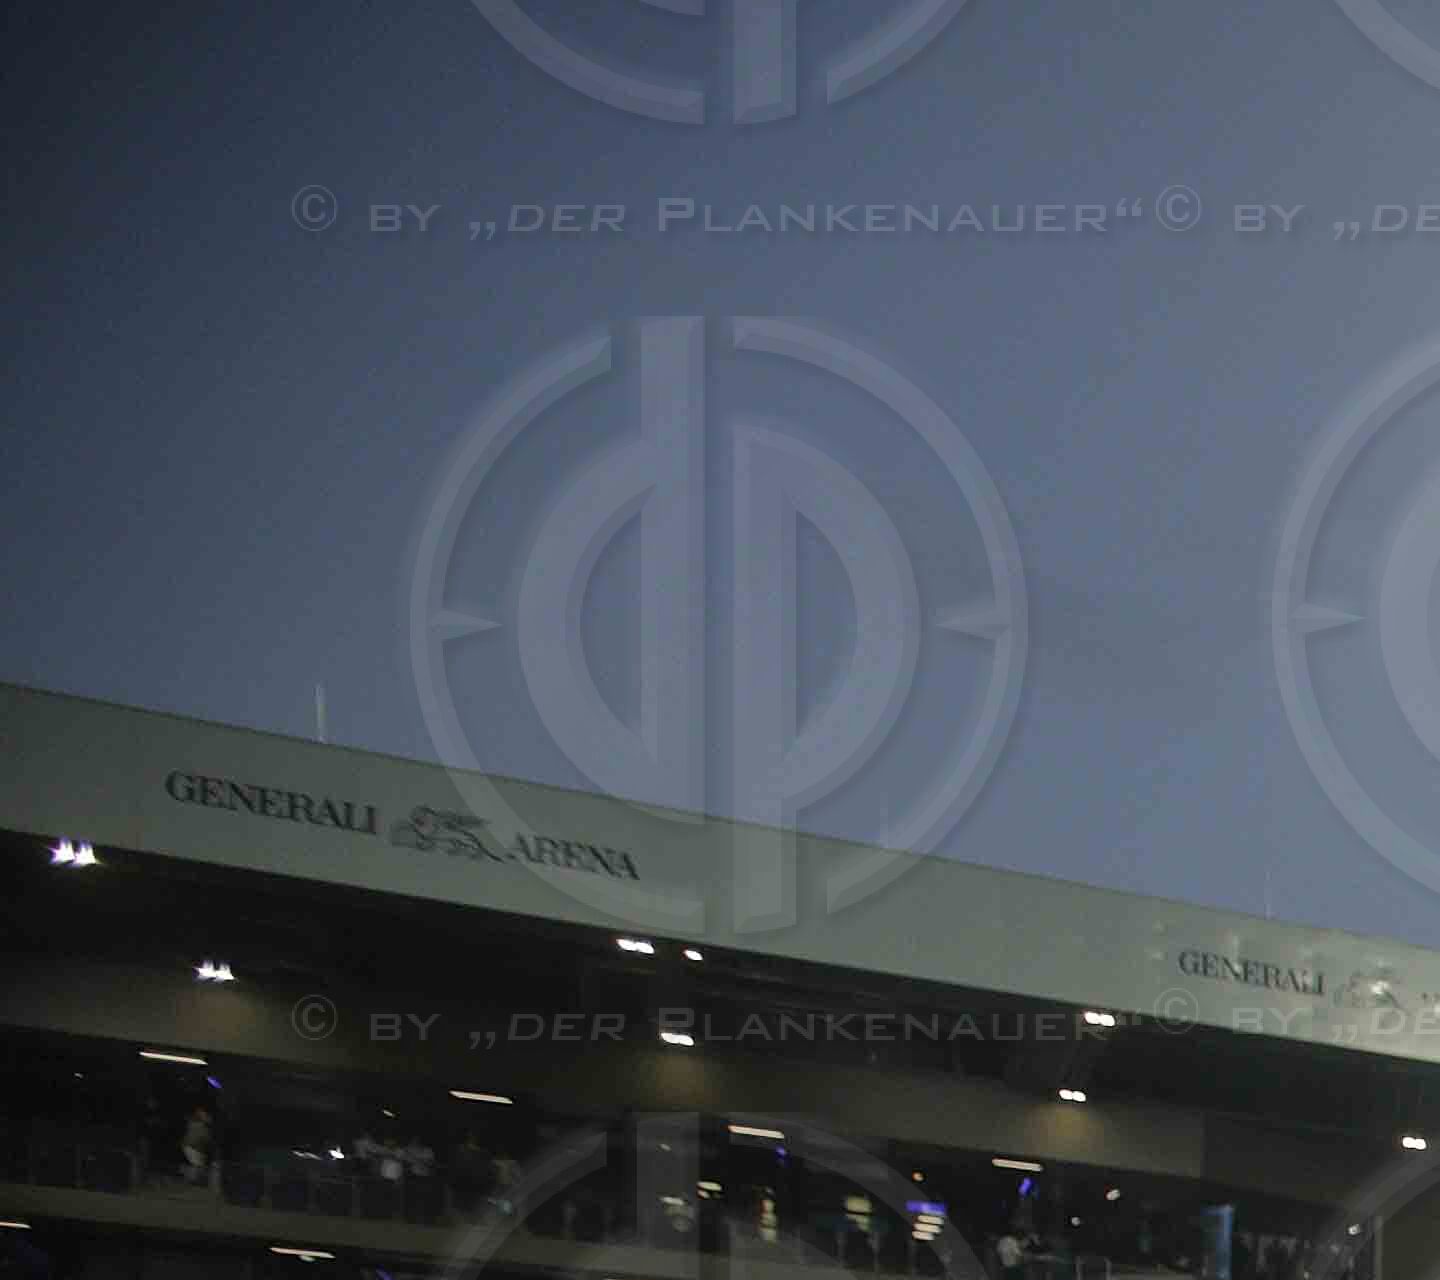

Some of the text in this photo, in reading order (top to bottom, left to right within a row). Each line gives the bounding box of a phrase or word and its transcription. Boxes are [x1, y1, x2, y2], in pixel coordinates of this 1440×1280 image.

[164, 769, 642, 882] GENERALI ARENA
[1178, 950, 1326, 997] GENERALI
